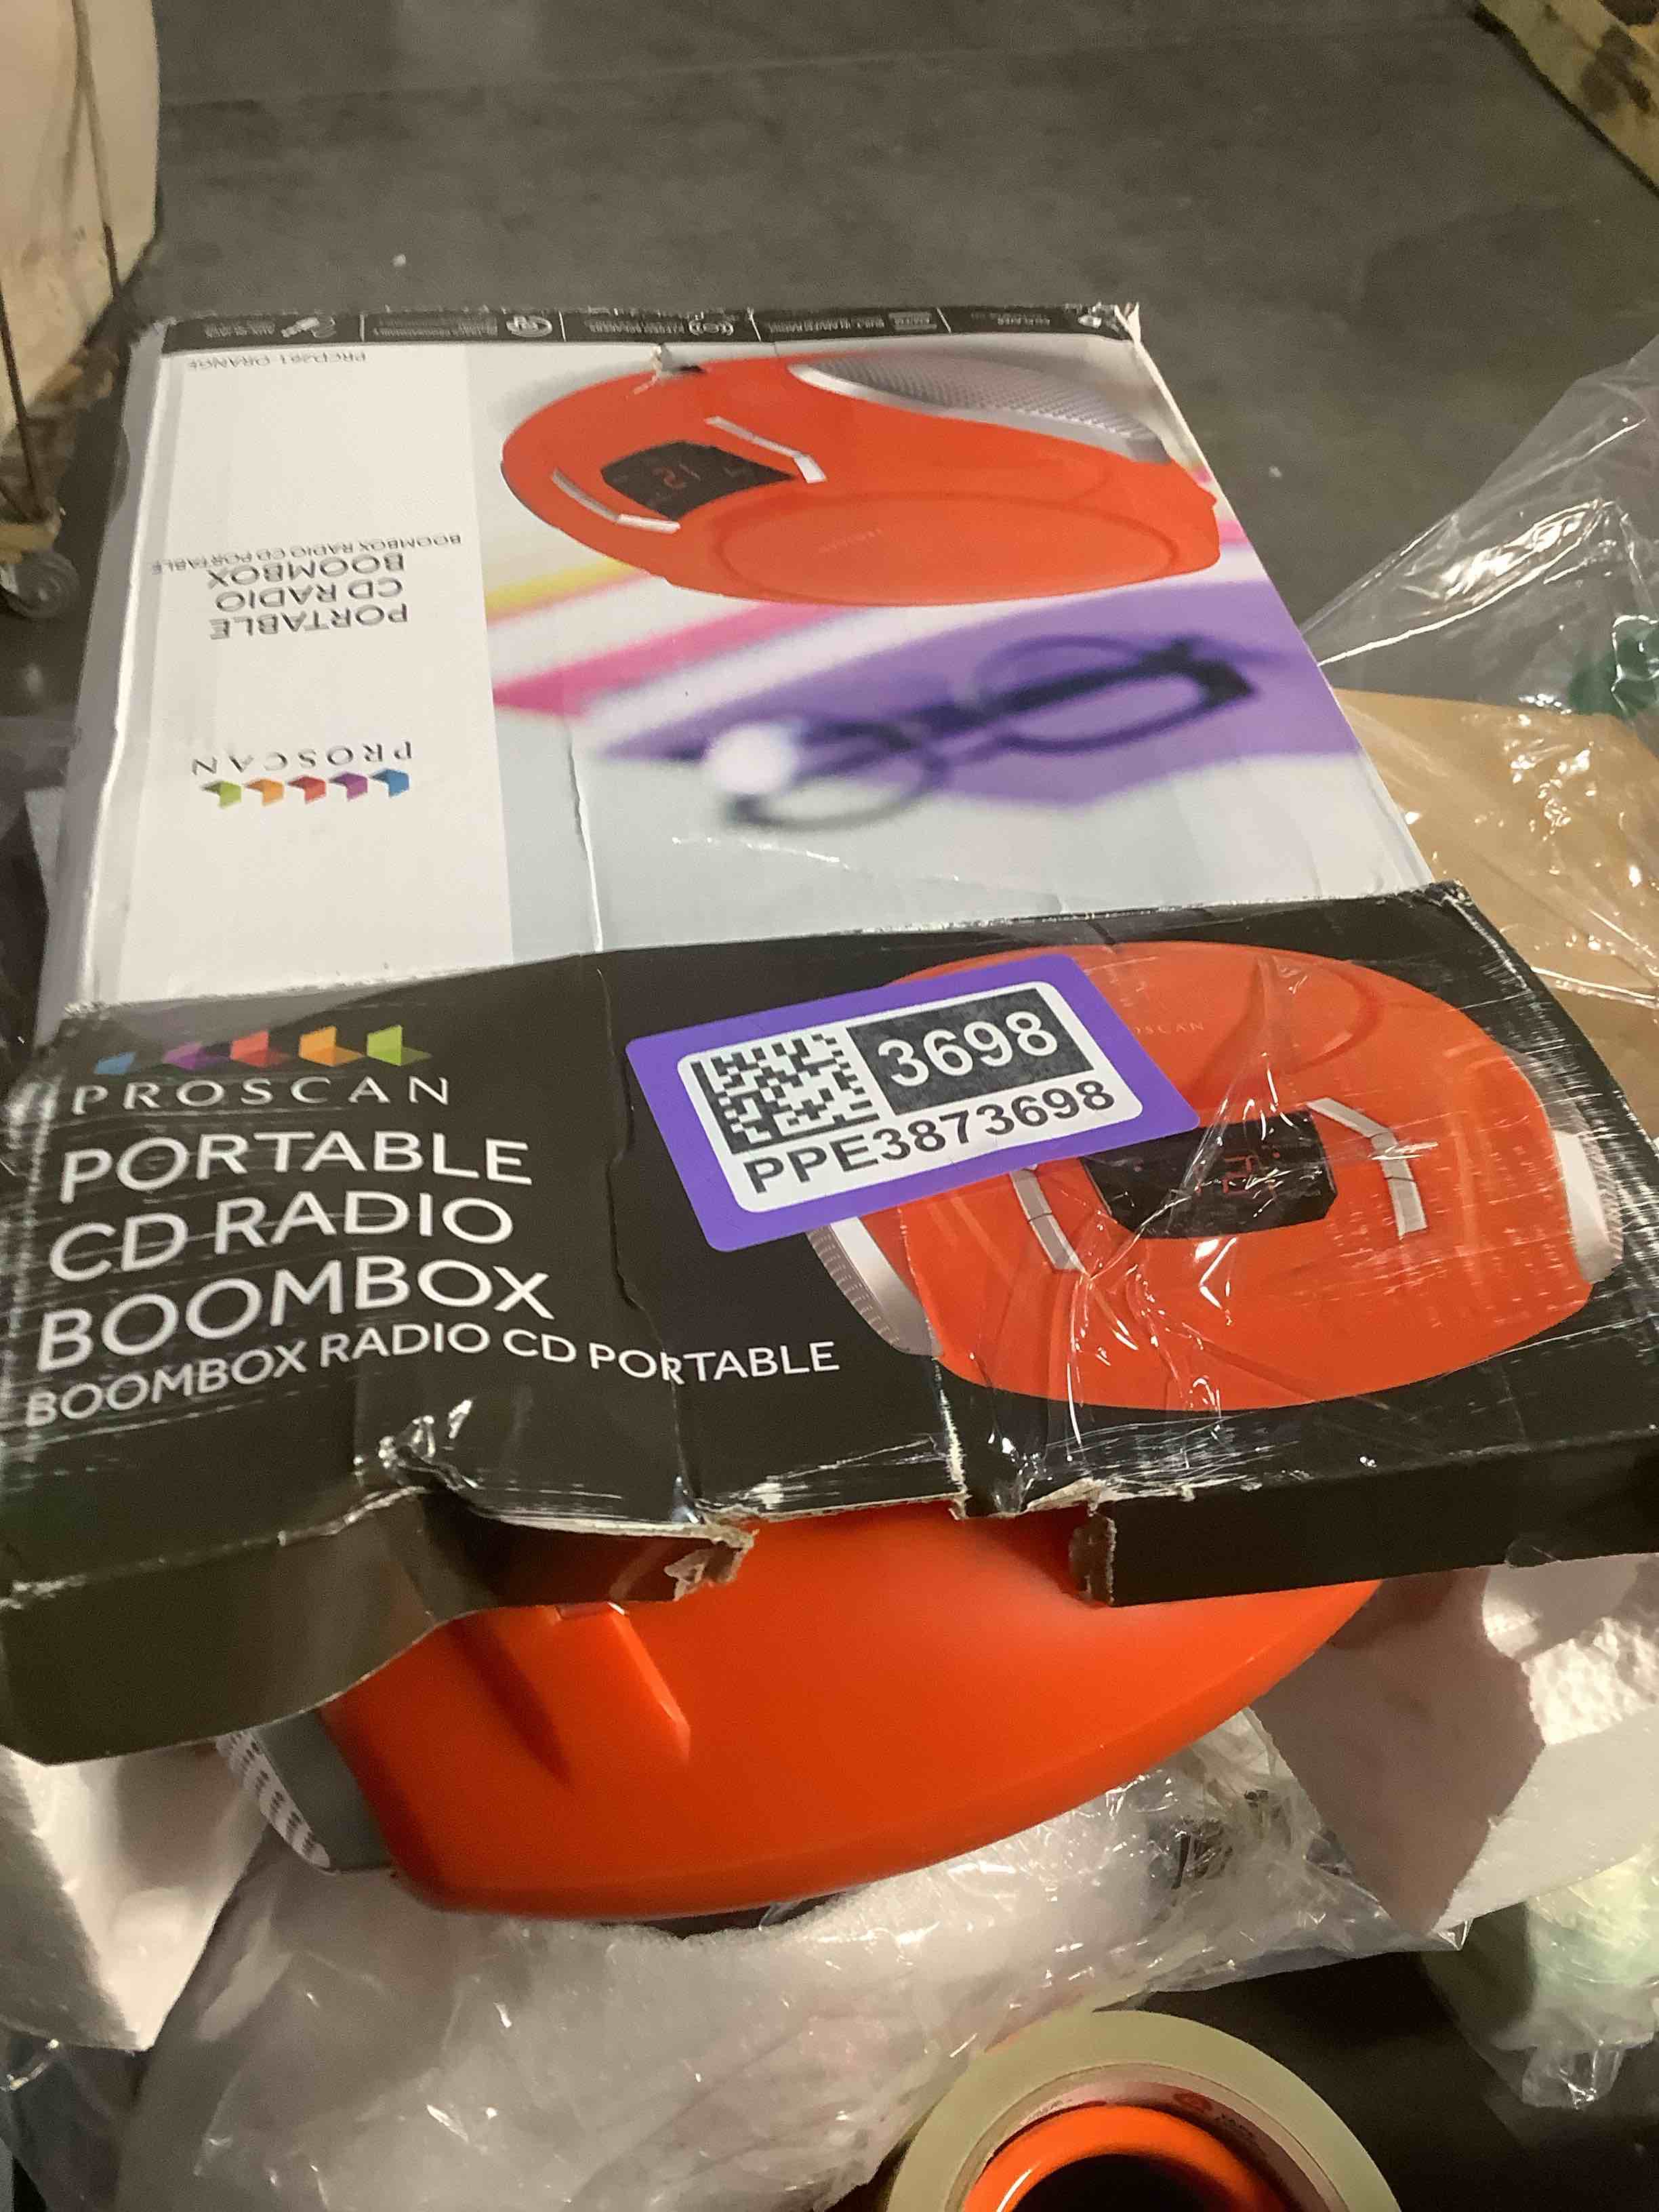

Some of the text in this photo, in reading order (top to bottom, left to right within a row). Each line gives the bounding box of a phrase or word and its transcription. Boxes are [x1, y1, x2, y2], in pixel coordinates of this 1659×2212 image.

[152, 534, 462, 575] BOOMBOX RADIO CD PORTABLE
[207, 552, 404, 589] BOOMBOX
[210, 603, 407, 640] PORTABLE
[216, 577, 403, 612] CD RADIO
[191, 741, 412, 775] PROSCAN
[877, 1010, 1058, 1087] 3698
[70, 1076, 451, 1115] PROSCAN
[743, 1080, 1115, 1193] PPE3873698
[60, 1130, 533, 1204] PORTABLE
[49, 1190, 514, 1282] CD RADIO
[37, 1254, 555, 1373] BOOMBOX
[25, 1322, 840, 1428] BOOMBOX RADIO CD PORTABLE
